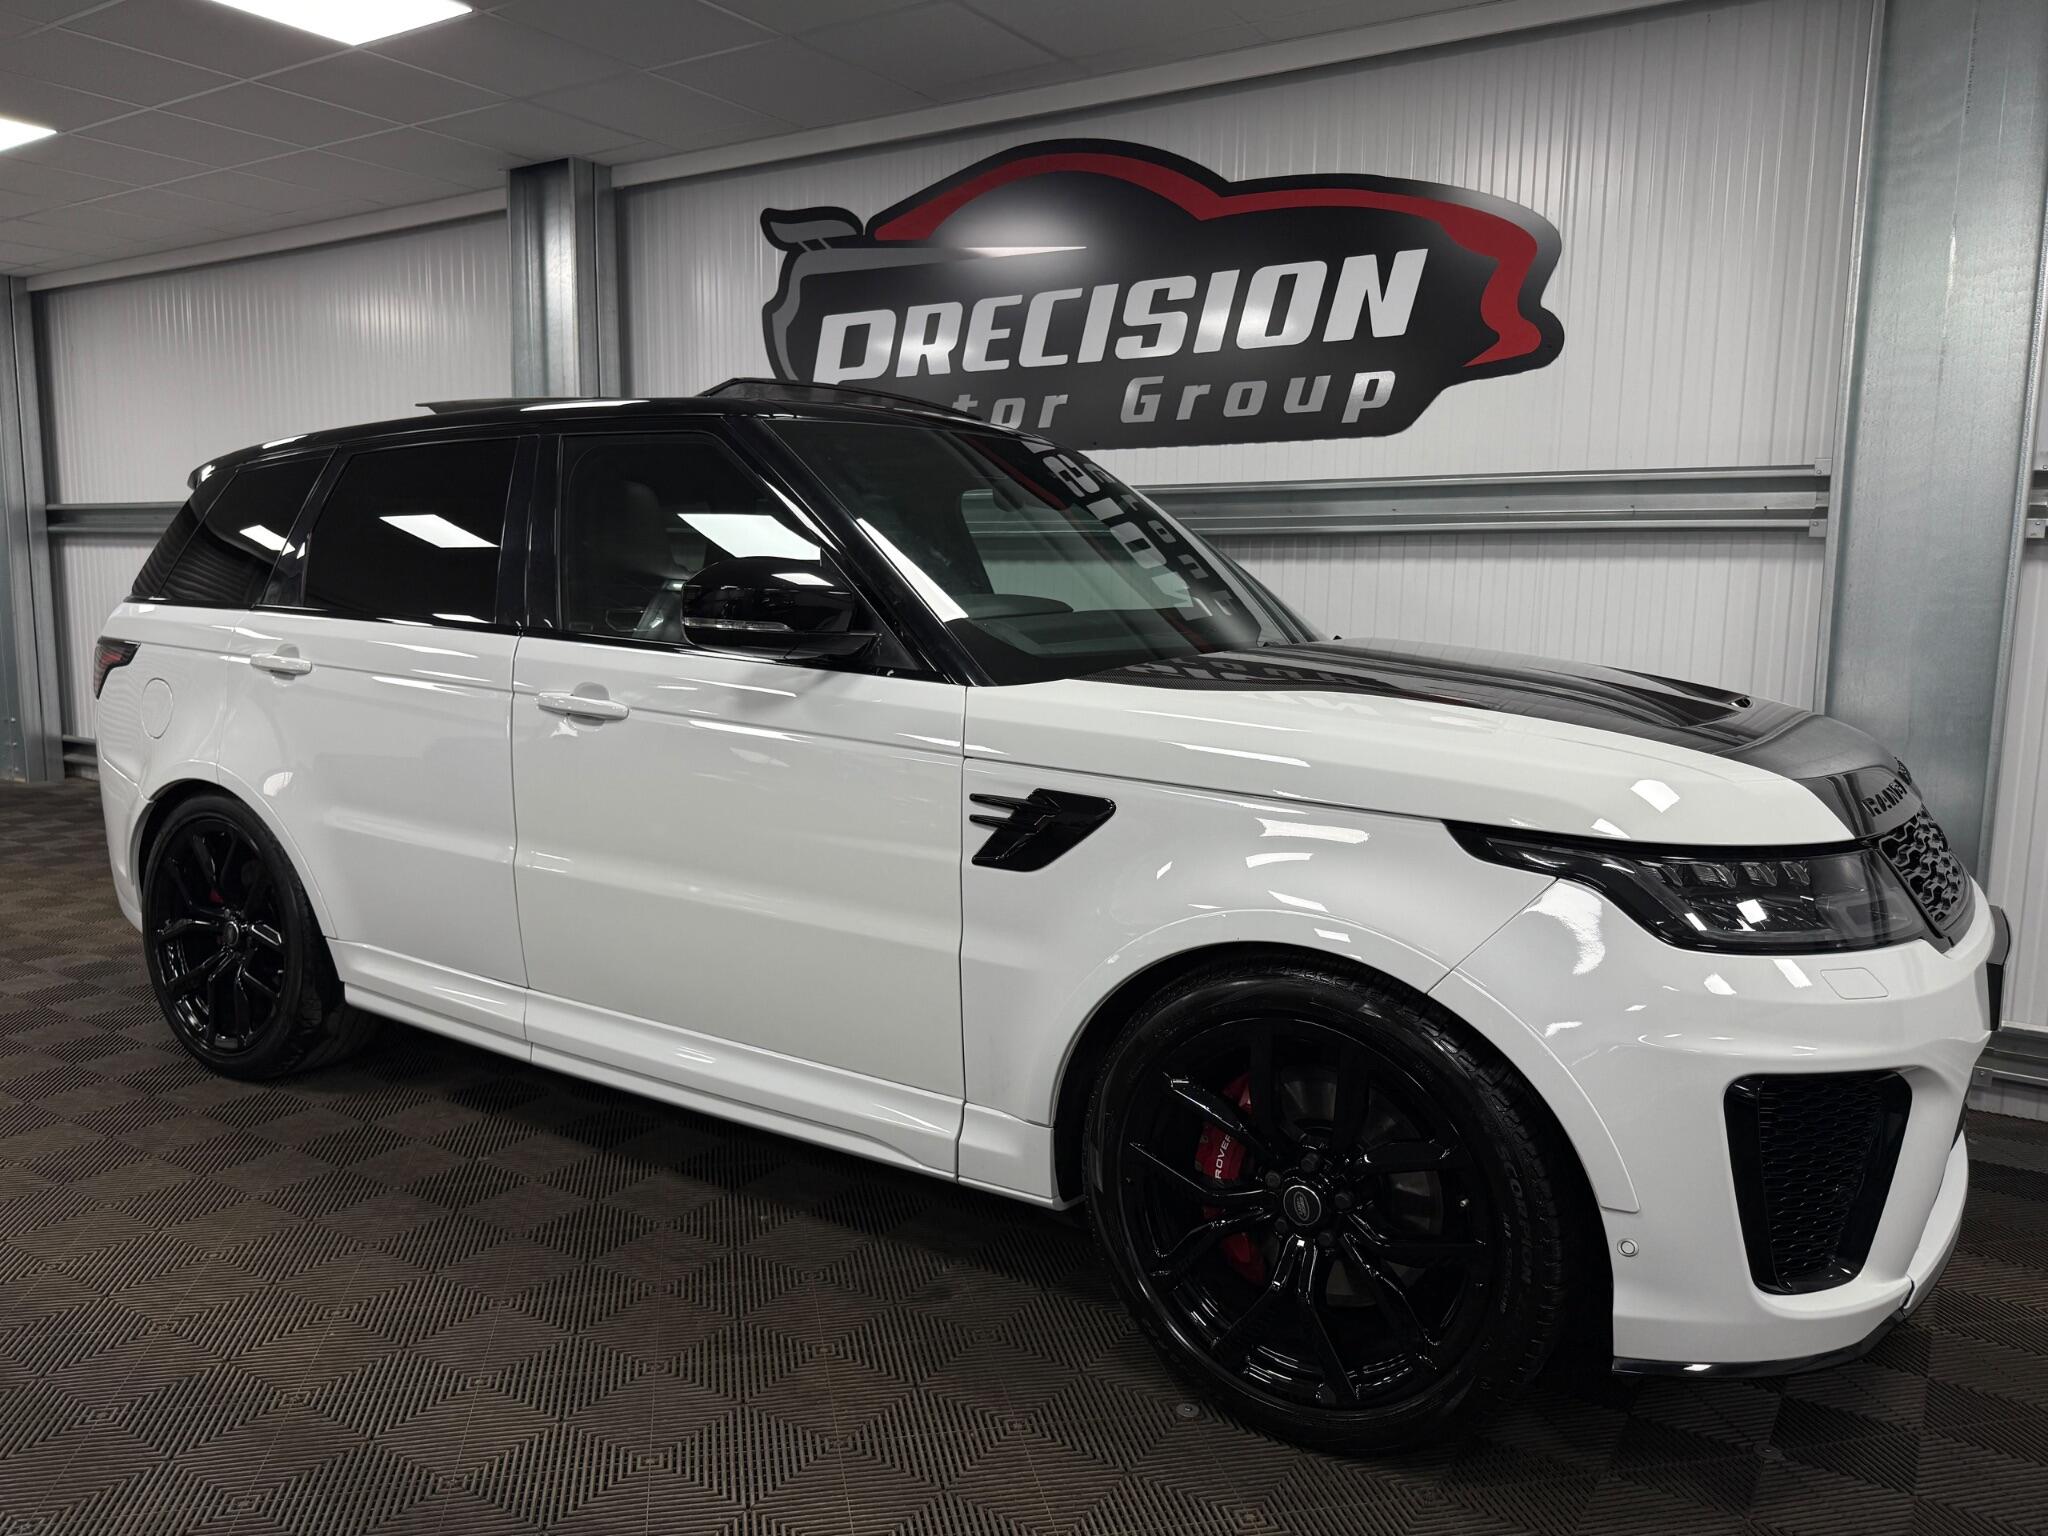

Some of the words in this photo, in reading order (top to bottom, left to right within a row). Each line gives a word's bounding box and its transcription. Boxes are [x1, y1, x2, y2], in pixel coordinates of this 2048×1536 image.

[812, 249, 1429, 386] PRECISION
[951, 394, 1069, 430] tor
[1120, 370, 1397, 424] Group
